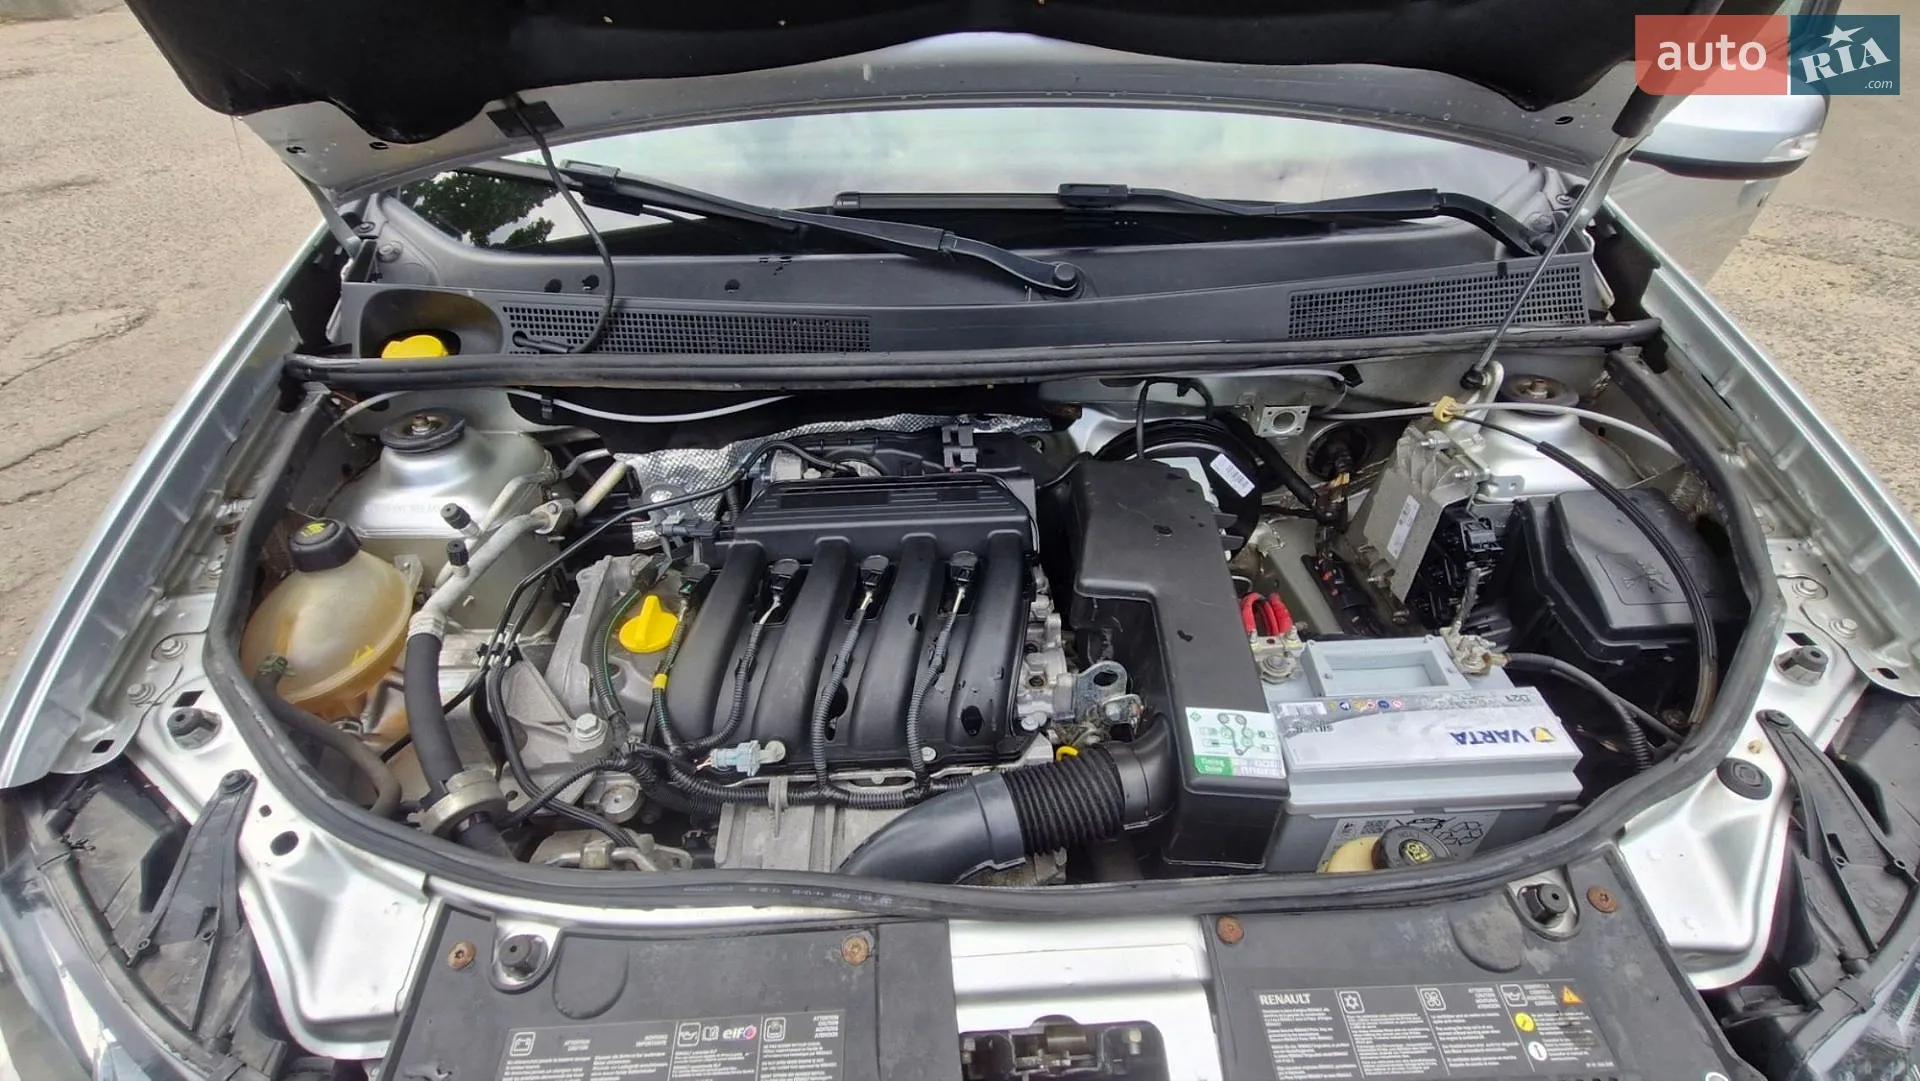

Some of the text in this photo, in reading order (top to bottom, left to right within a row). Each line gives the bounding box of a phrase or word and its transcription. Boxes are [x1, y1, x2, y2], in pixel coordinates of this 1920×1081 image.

[1450, 728, 1530, 746] VARTA
[1259, 993, 1311, 1006] RENAULT
[722, 1026, 745, 1040] elf
